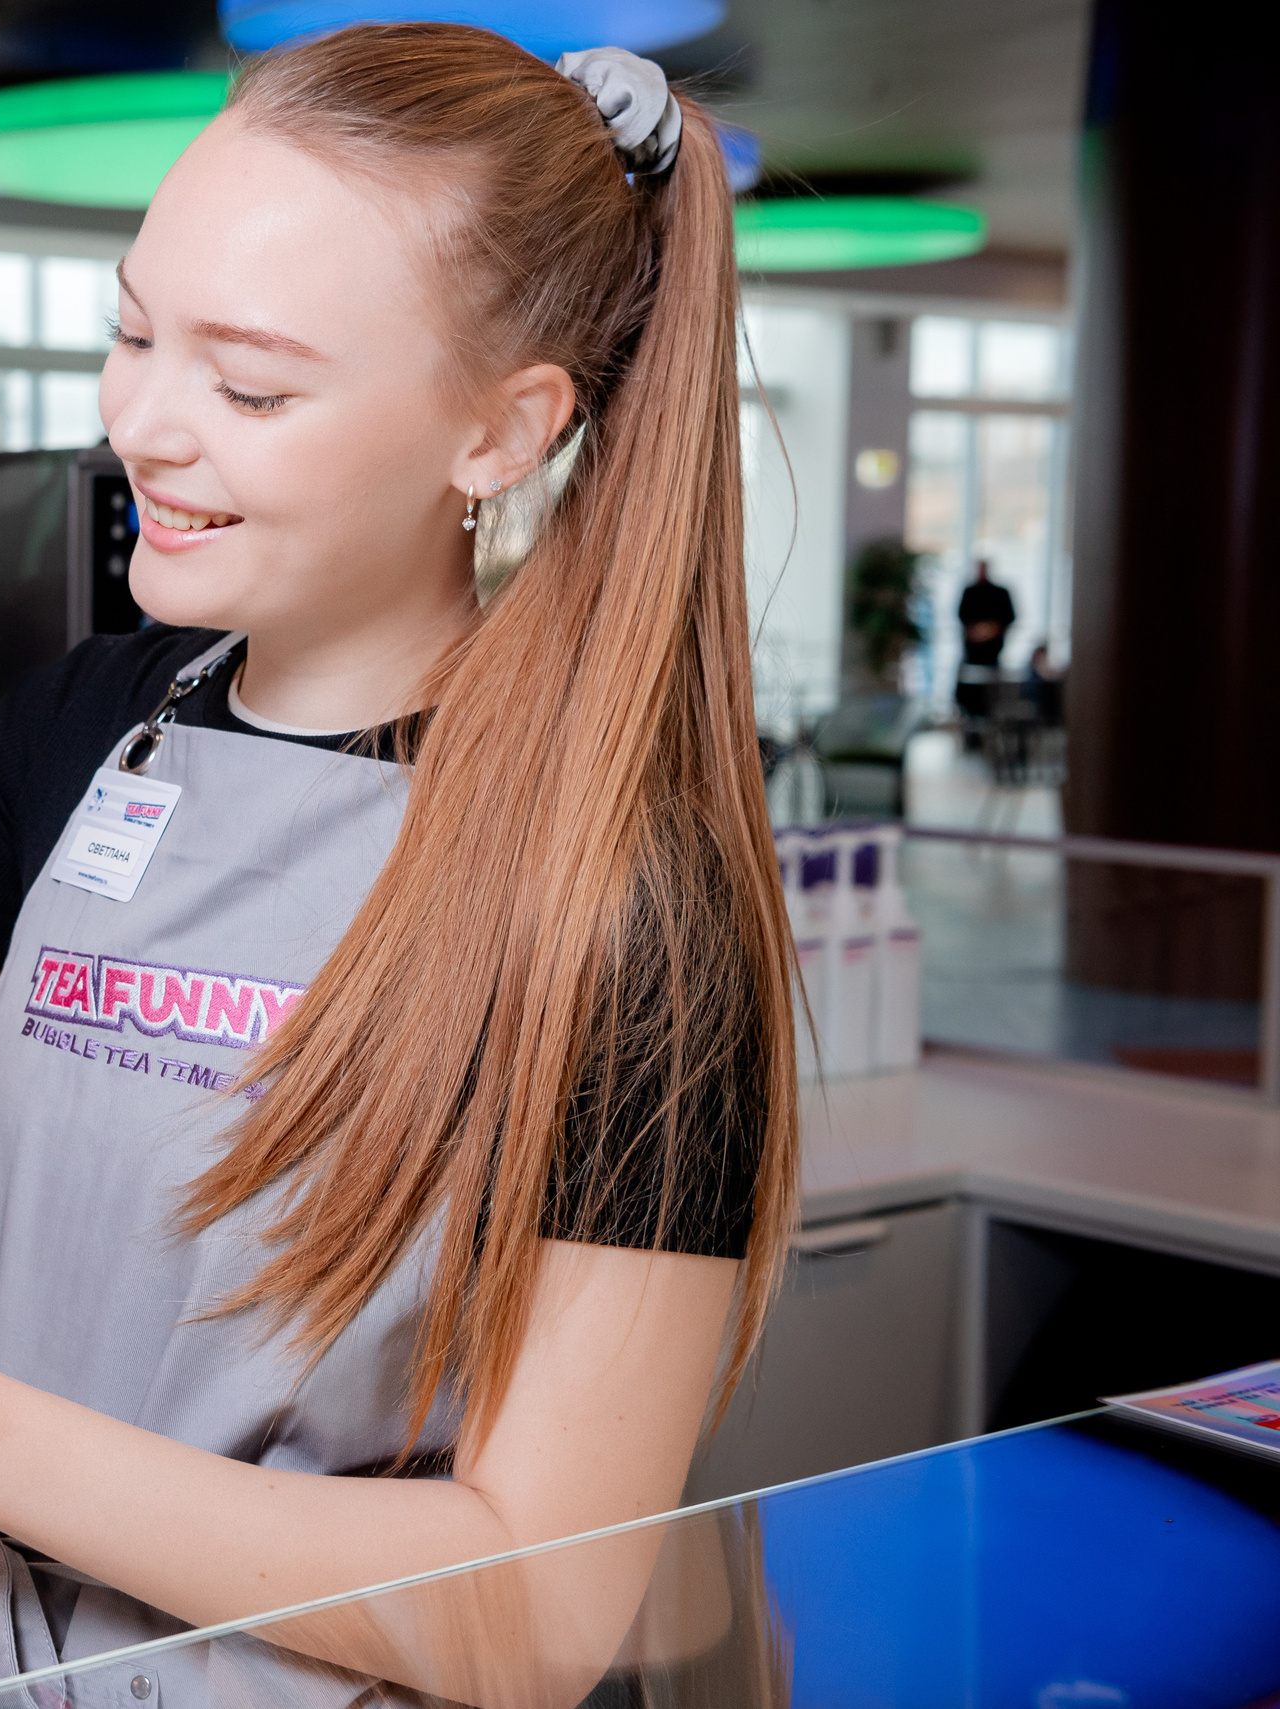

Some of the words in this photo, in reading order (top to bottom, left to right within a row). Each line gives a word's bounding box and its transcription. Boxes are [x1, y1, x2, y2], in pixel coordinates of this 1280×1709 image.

[87, 842, 131, 863] СВЕТЛАНА
[34, 957, 91, 1015] TEA
[21, 1017, 100, 1060] BUBBLE
[104, 1043, 150, 1075] TEA
